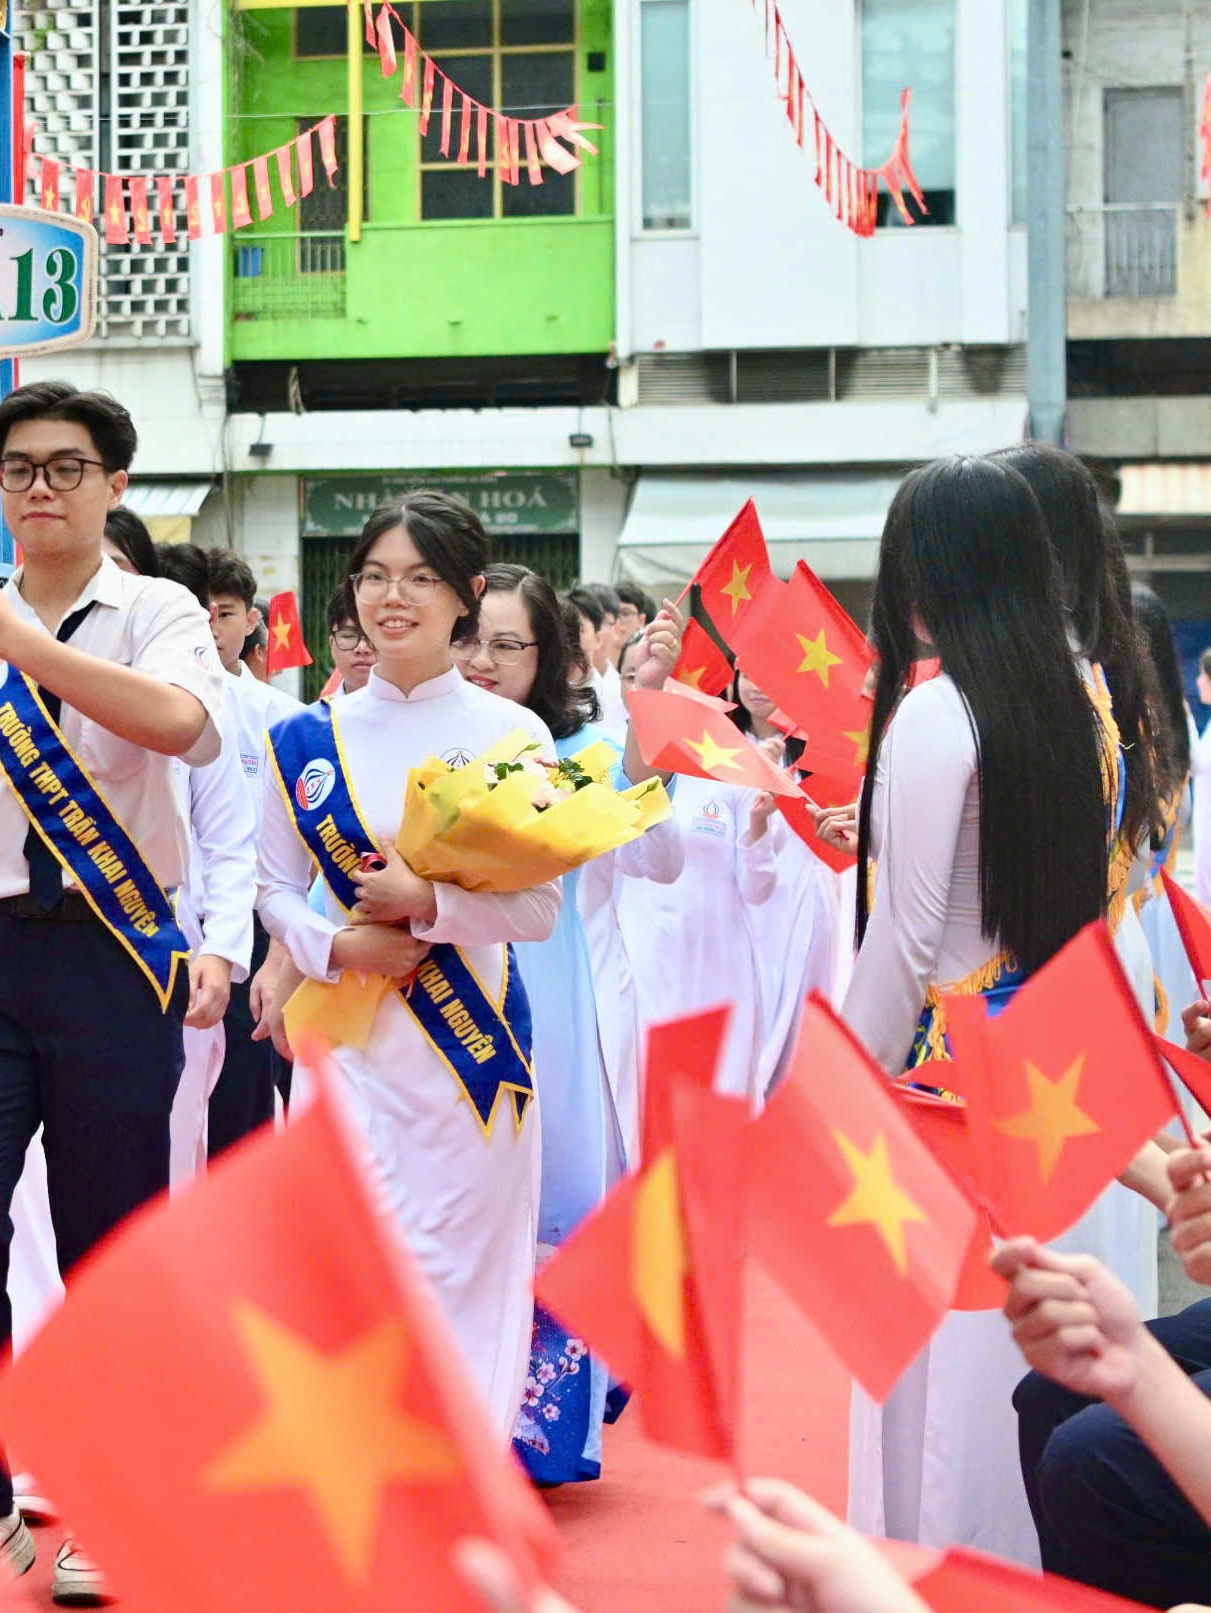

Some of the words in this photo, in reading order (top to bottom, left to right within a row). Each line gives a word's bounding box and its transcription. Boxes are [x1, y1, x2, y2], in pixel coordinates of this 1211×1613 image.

[29, 761, 69, 805] THPT
[58, 799, 101, 846] TRẦN
[87, 840, 128, 884] KHAI
[113, 878, 160, 938] NGUYÊN
[439, 998, 497, 1065] NGUYÊN
